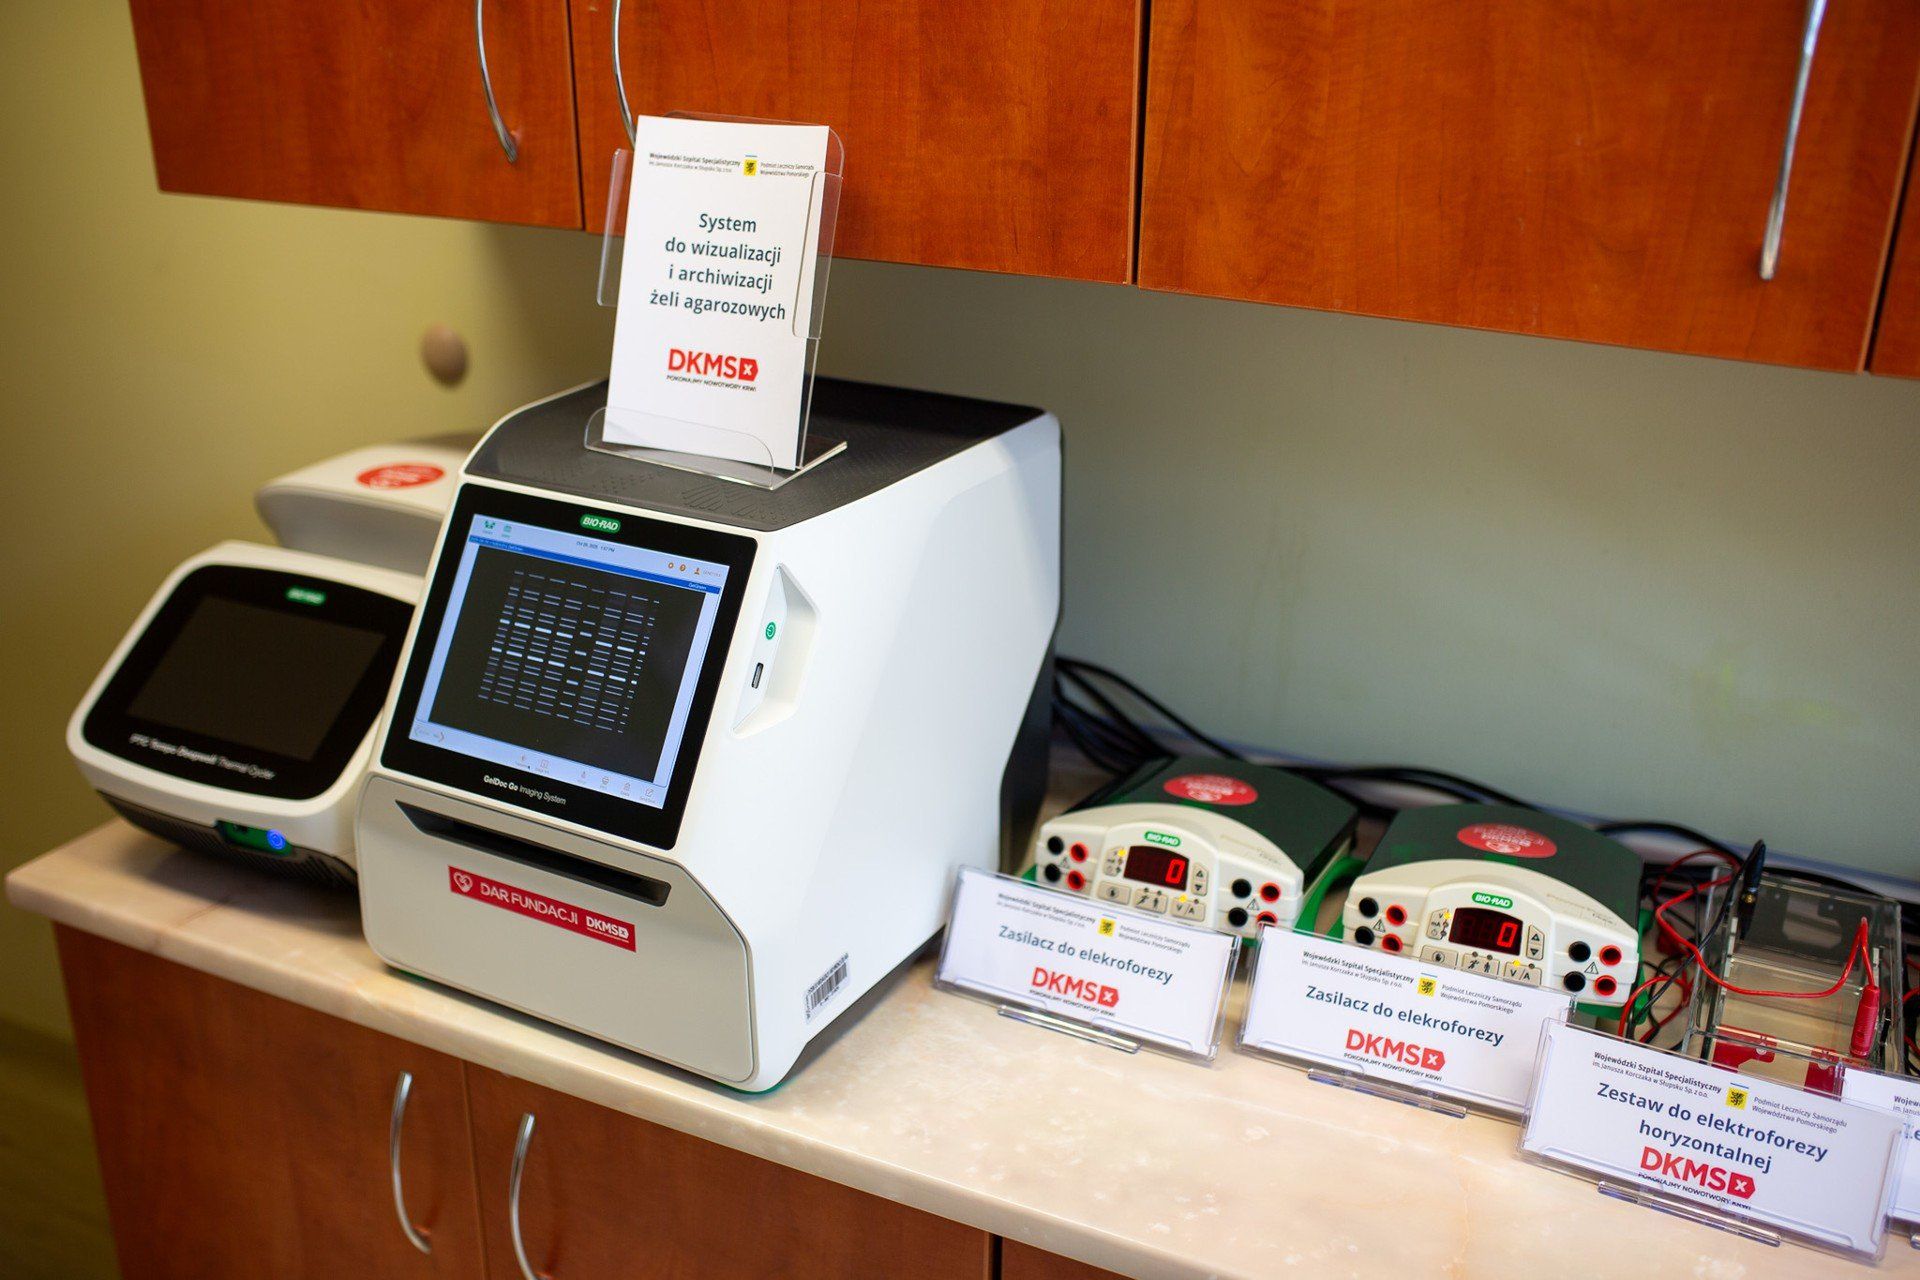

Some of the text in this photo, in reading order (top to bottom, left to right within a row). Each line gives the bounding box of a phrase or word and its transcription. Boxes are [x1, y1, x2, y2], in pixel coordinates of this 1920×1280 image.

[699, 213, 757, 233] System
[665, 237, 781, 266] do wizualizacji
[668, 265, 773, 293] i archiwizacji
[650, 289, 786, 322] żeli agarozowych
[668, 348, 737, 379] DKMS
[582, 516, 619, 530] BIO-RAD
[483, 775, 566, 805] GelDoc Go Imaging System
[1165, 858, 1186, 884] 0
[479, 882, 510, 903] DAR
[511, 893, 579, 926] FUNDACJI
[585, 915, 619, 938] DKMS
[1475, 894, 1511, 907] BIO-RAD
[1496, 921, 1518, 948] 0
[999, 925, 1174, 986] Zasilacz do elekroforezy
[1304, 952, 1414, 983] Wojewódzki Szpital Specjalistyczny
[1032, 966, 1096, 1002] DKMS
[1305, 985, 1504, 1047] Zasilacz do elekroforezy
[1345, 1028, 1420, 1066] DKMS
[1595, 1052, 1721, 1094] Wojewódzki Szpital Specjalistyczny
[1626, 1070, 1652, 1082] Korczaka
[1659, 1080, 1683, 1091] Słupsku
[1597, 1082, 1828, 1162] Zestaw do elektroforezy
[1753, 1106, 1837, 1134] Województwa Pomorskiego
[1754, 1097, 1847, 1127] Podmiot Leczniczy Samorządu
[1638, 1119, 1773, 1174] horyzontalnej
[1639, 1145, 1728, 1190] DKMS
[1683, 1186, 1731, 1204] NOWOTWORY
